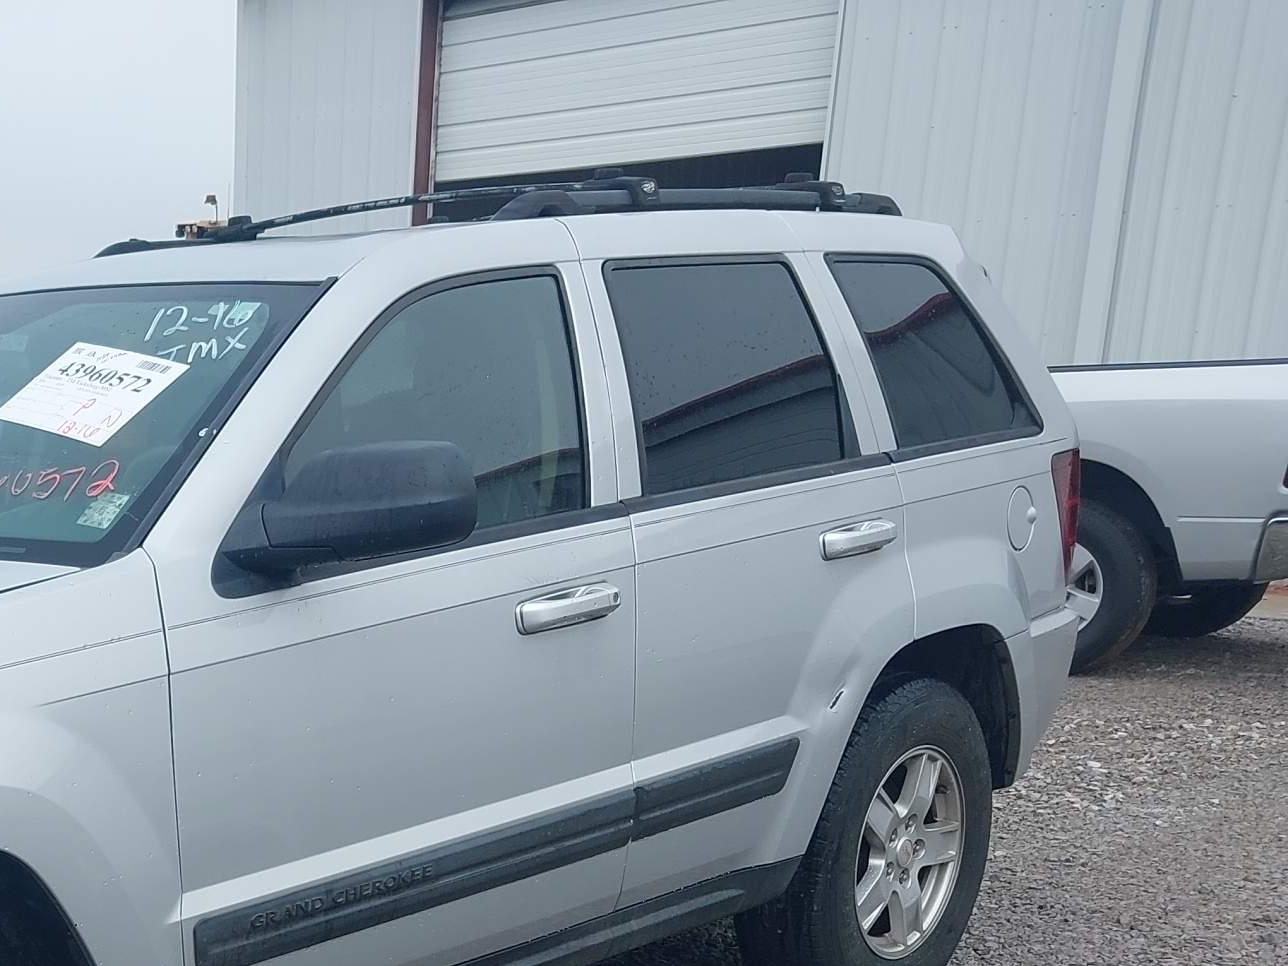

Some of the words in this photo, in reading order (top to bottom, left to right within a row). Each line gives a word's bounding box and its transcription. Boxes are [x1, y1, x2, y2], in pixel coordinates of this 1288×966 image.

[57, 361, 153, 393] 43960572
[251, 897, 323, 928] GRAND
[332, 864, 432, 904] CHEROKEE
